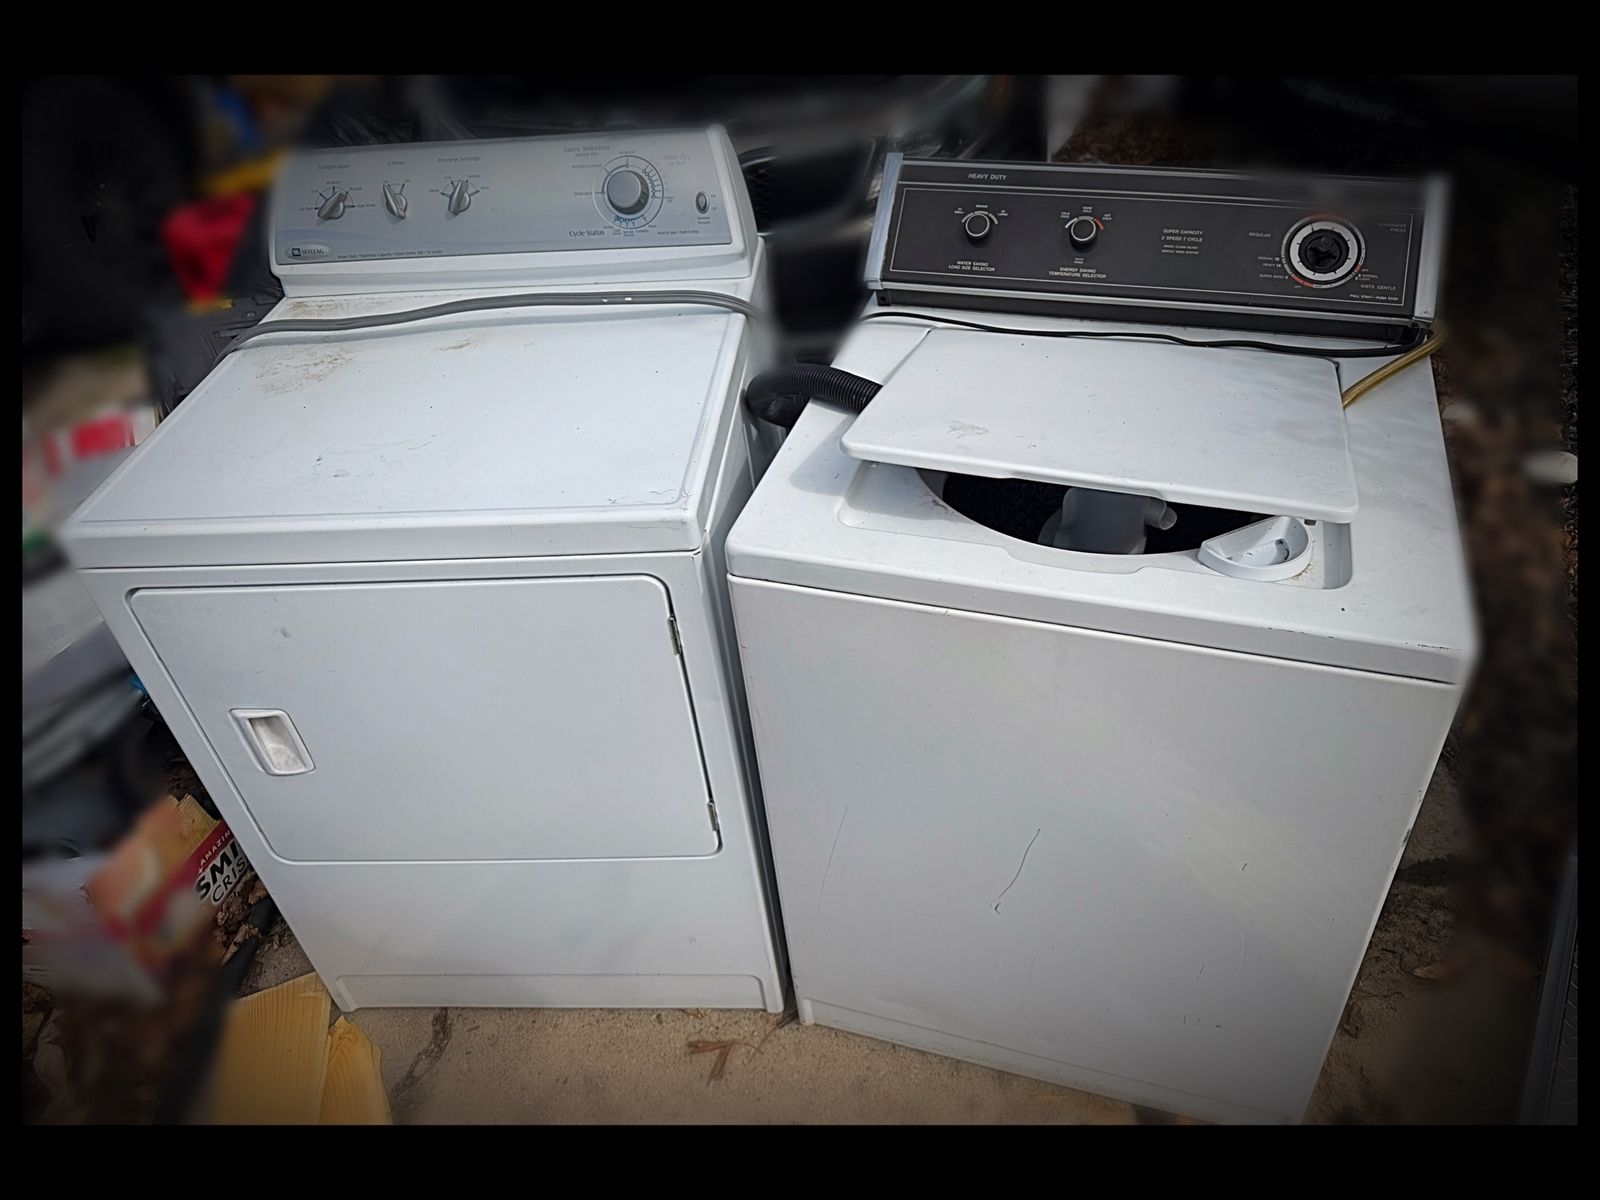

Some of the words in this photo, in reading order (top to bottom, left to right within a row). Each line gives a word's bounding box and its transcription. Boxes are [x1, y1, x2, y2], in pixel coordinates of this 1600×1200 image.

[569, 230, 585, 238] Cycle
[586, 229, 605, 237] Status
[200, 829, 231, 867] AMAZIN
[212, 858, 246, 902] CRIS
